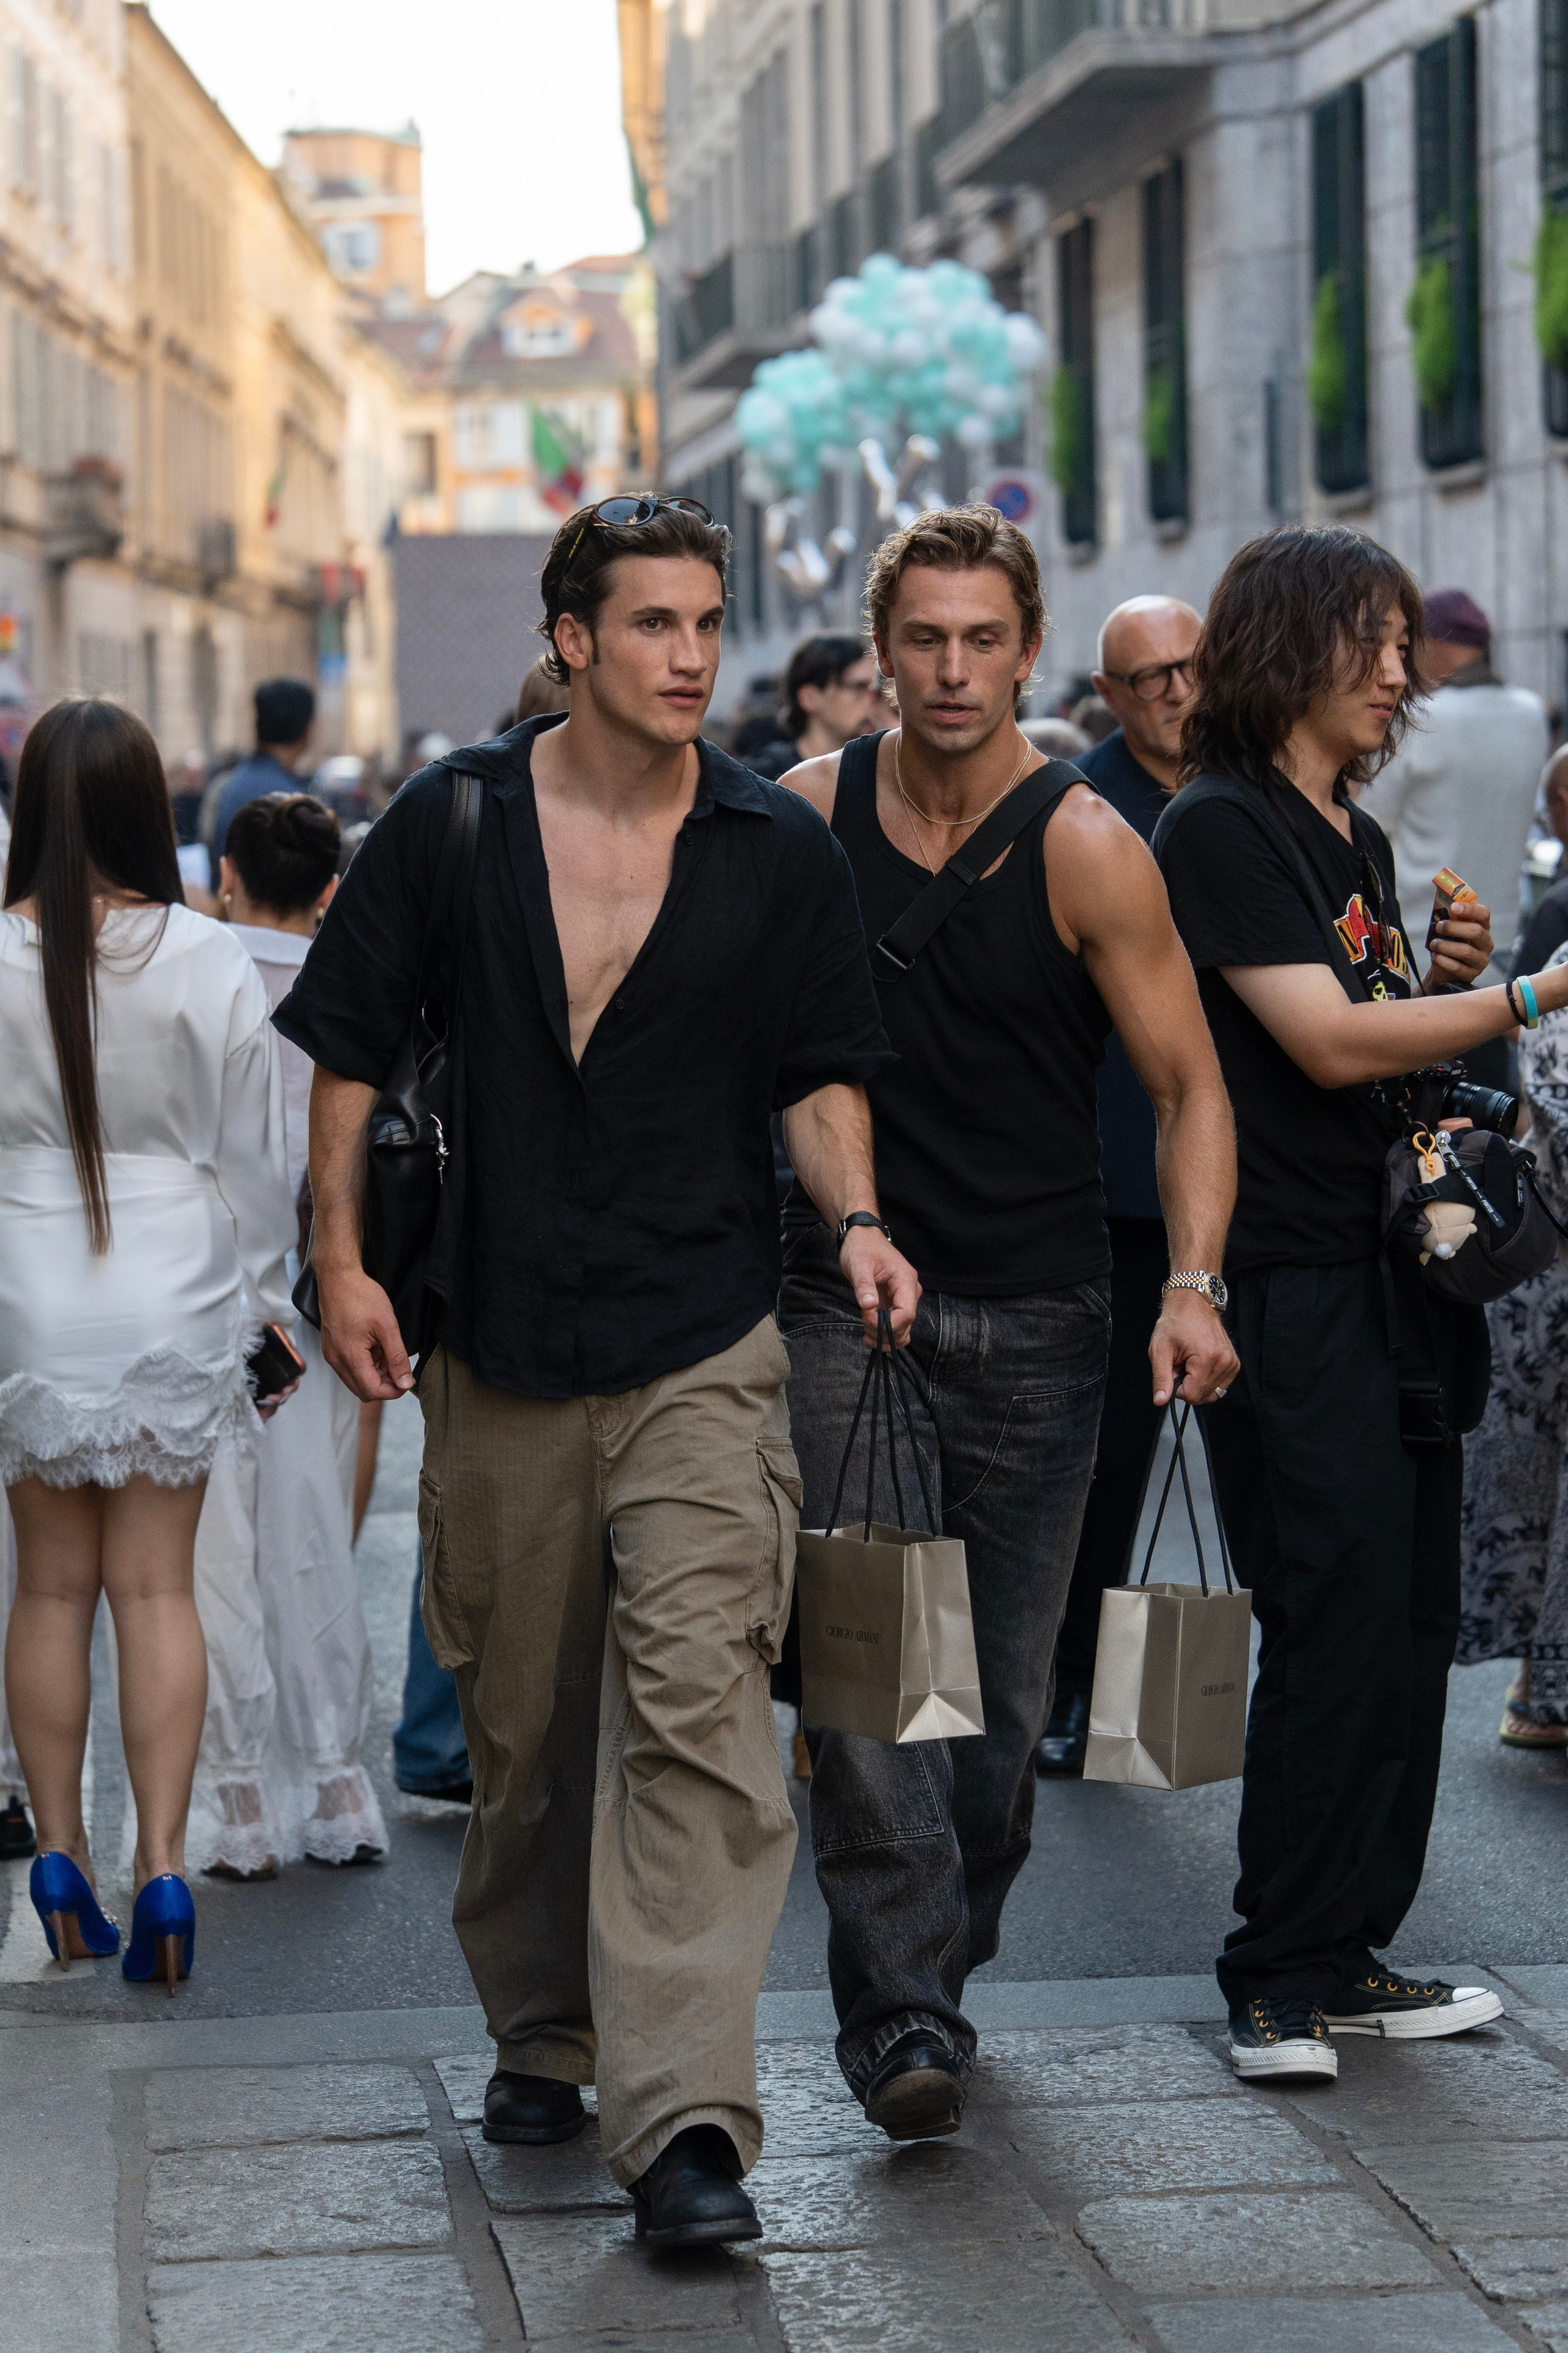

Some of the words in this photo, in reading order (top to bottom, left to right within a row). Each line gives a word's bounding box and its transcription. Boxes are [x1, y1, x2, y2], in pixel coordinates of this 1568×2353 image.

[1465, 1176, 1477, 1190] PORTER
[1482, 1199, 1494, 1214] PORTER
[826, 1625, 853, 1640] GIORGIO
[855, 1630, 879, 1644] ARMANI
